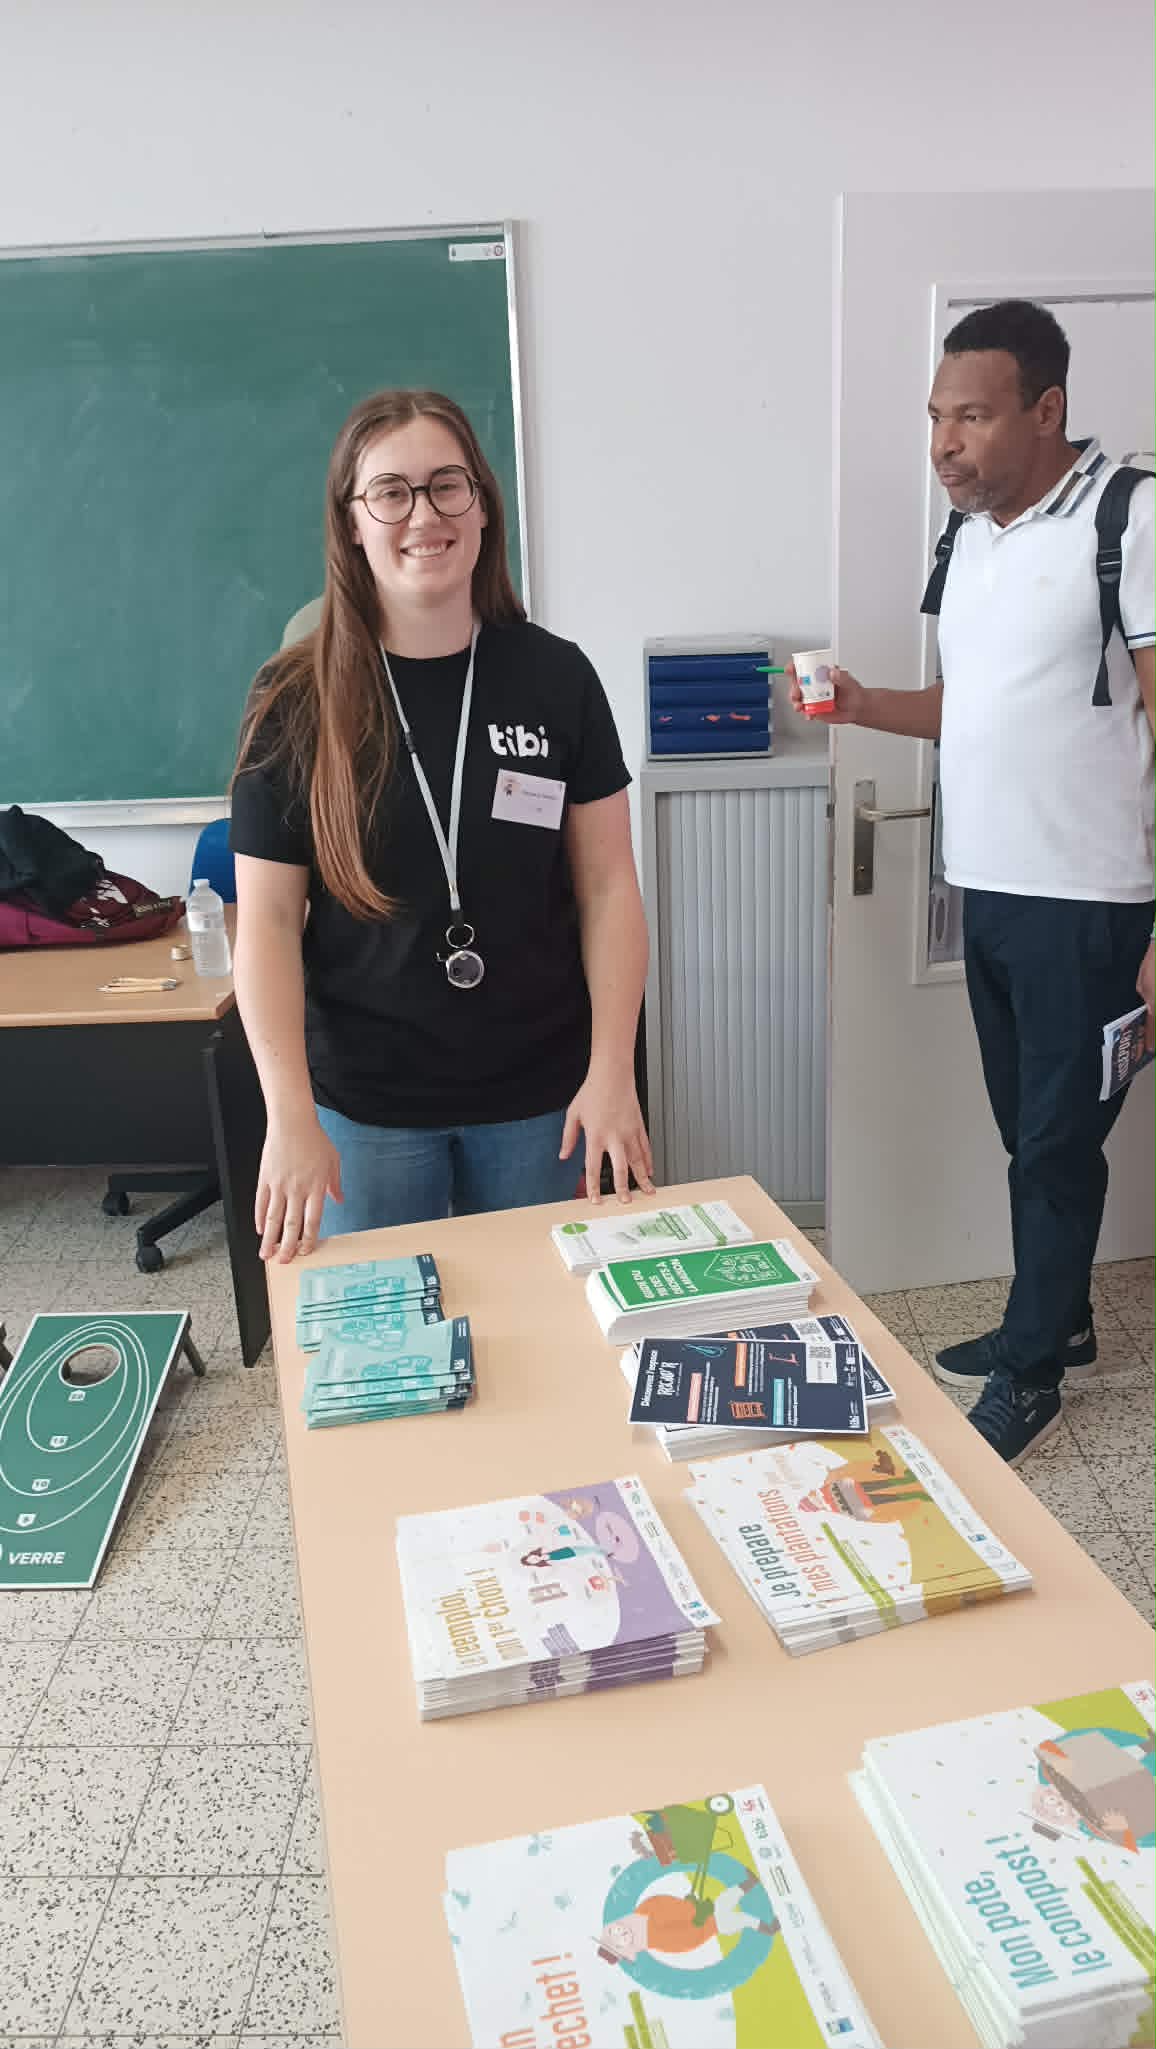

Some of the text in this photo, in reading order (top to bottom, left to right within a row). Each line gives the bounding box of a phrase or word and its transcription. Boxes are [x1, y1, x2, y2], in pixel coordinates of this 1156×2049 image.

[487, 724, 549, 758] tibi
[8, 1552, 66, 1565] VERRE
[757, 1488, 840, 1592] mes plantations
[472, 1576, 509, 1619] choix
[769, 1582, 801, 1597] Je
[995, 1844, 1091, 1947] compost
[965, 1871, 1059, 1989] Mon pote,
[1071, 1949, 1112, 1977] le
